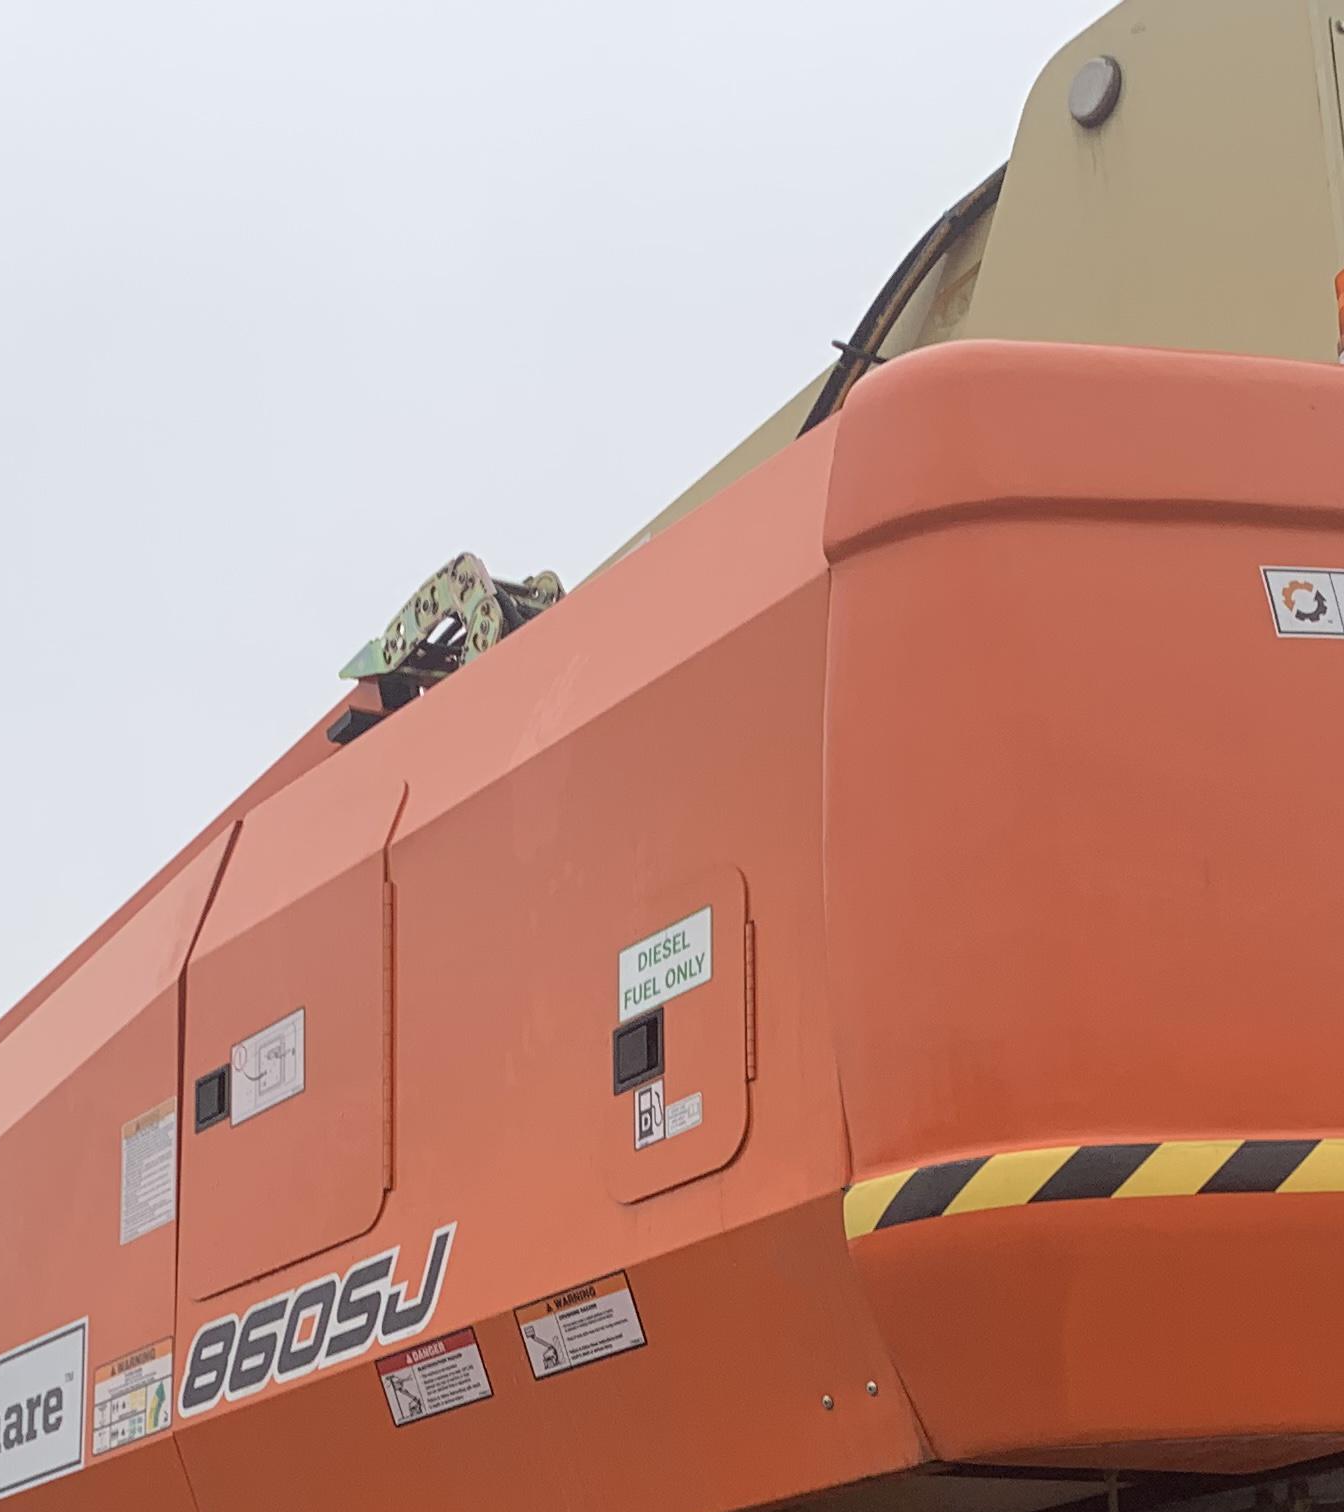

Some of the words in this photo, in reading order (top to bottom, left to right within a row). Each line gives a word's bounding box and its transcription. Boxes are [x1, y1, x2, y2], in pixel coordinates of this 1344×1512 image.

[637, 930, 691, 973] DIESEL
[623, 978, 662, 1011] FUEL
[665, 952, 706, 990] ONLY
[180, 1224, 456, 1414] 860SJ
